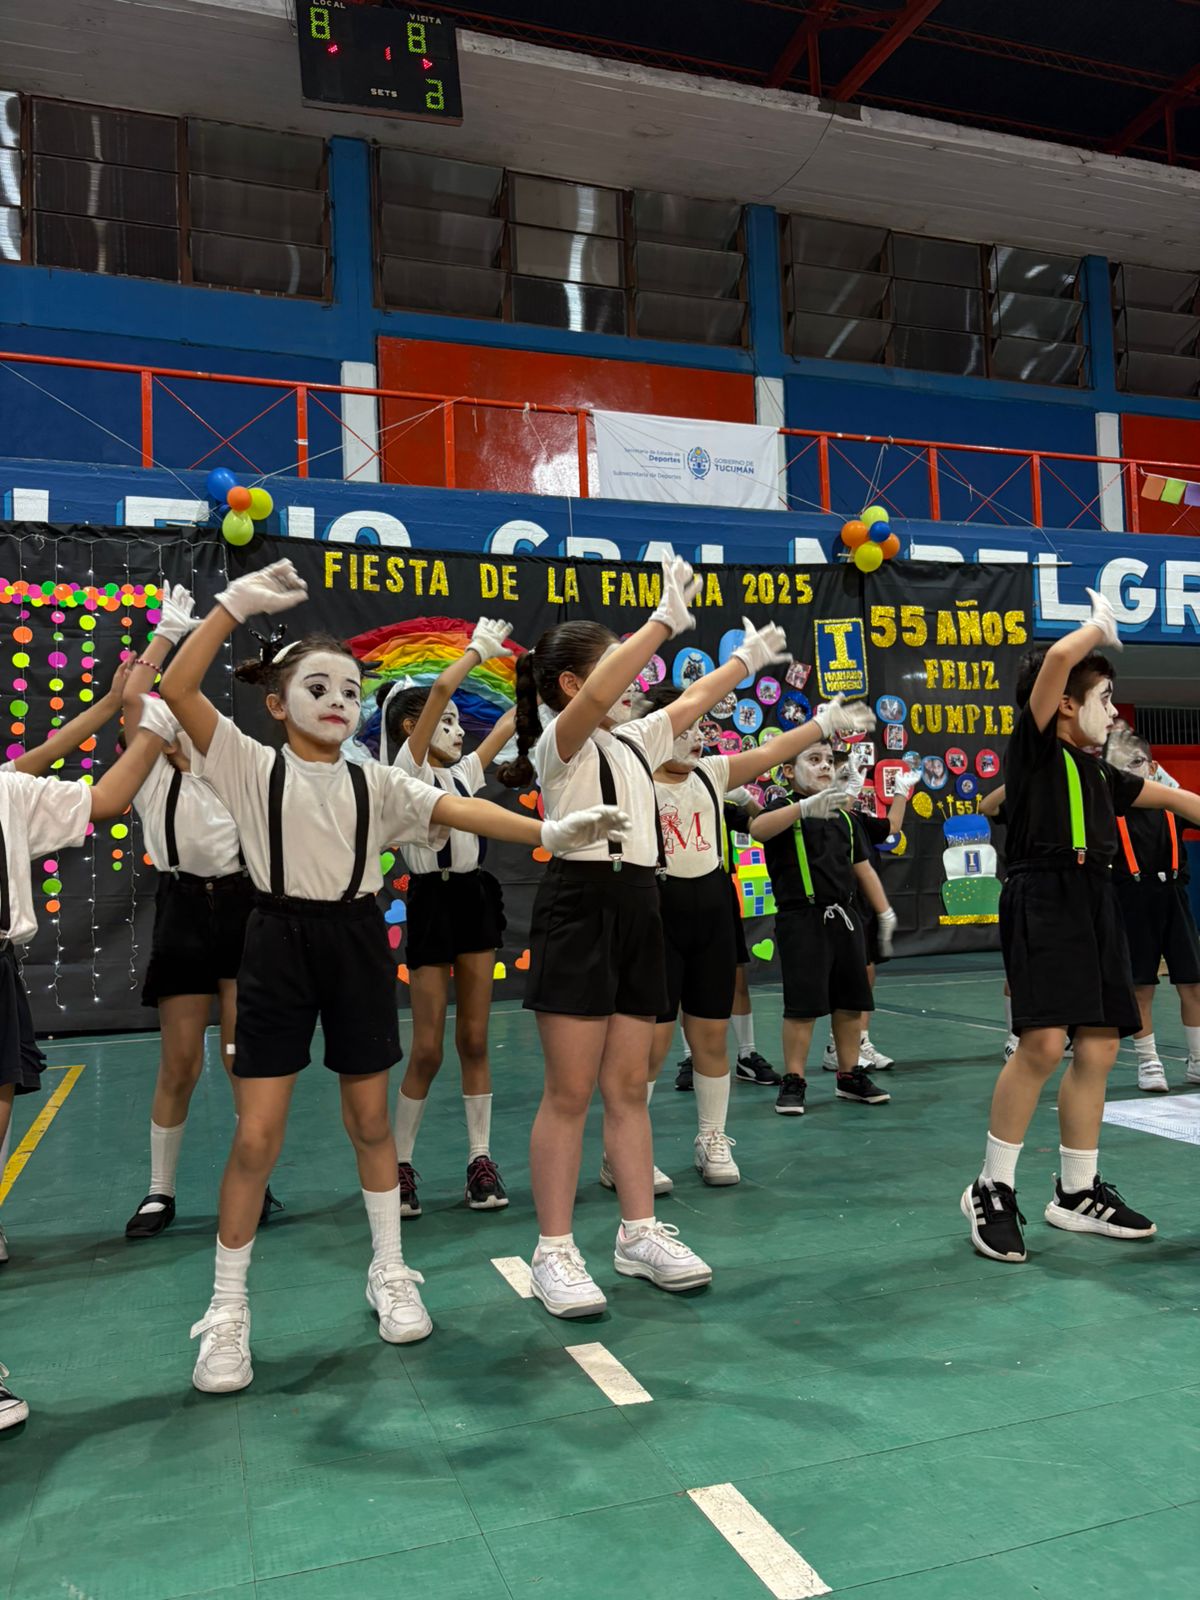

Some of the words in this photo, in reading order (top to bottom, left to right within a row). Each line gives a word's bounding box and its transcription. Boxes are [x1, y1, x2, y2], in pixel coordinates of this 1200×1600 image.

[312, 0, 346, 9] LOCAL
[409, 13, 442, 25] VISITA
[310, 6, 330, 39] 8
[407, 21, 426, 54] 8
[370, 87, 398, 98] SETS
[648, 454, 681, 464] Deportes
[714, 457, 745, 466] GOBIERNO
[324, 551, 450, 597] FIESTA
[479, 562, 520, 601] DE
[547, 566, 580, 604] LA
[741, 572, 814, 605] 2025
[870, 604, 929, 648] 55
[936, 599, 1028, 647] AÑOS
[824, 623, 858, 670] I
[923, 658, 1000, 691] FELIZ
[910, 703, 1015, 736] CUMPLE
[956, 801, 974, 815] 55
